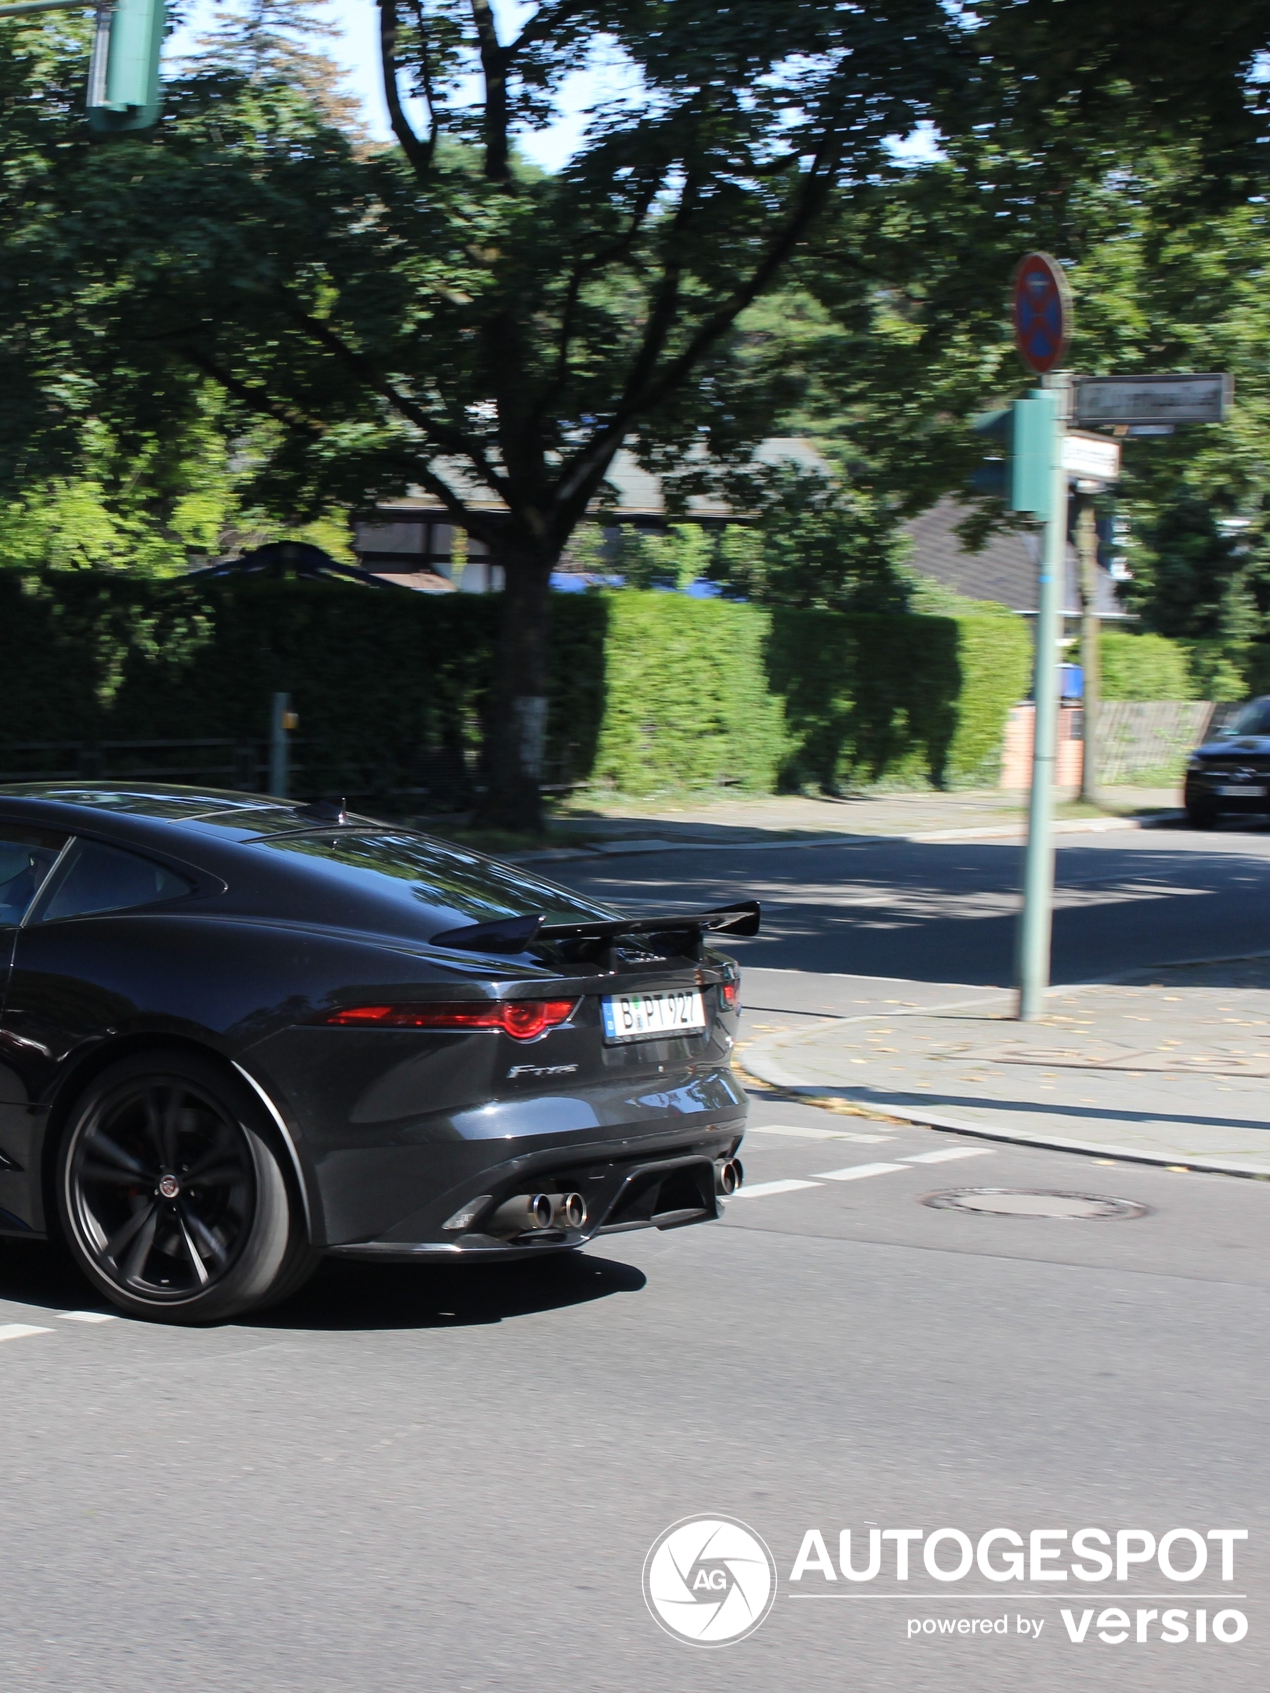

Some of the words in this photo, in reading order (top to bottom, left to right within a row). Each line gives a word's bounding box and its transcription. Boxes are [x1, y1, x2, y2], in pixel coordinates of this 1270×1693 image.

[620, 997, 633, 1030] B
[641, 994, 663, 1027] PT
[667, 991, 693, 1025] 927
